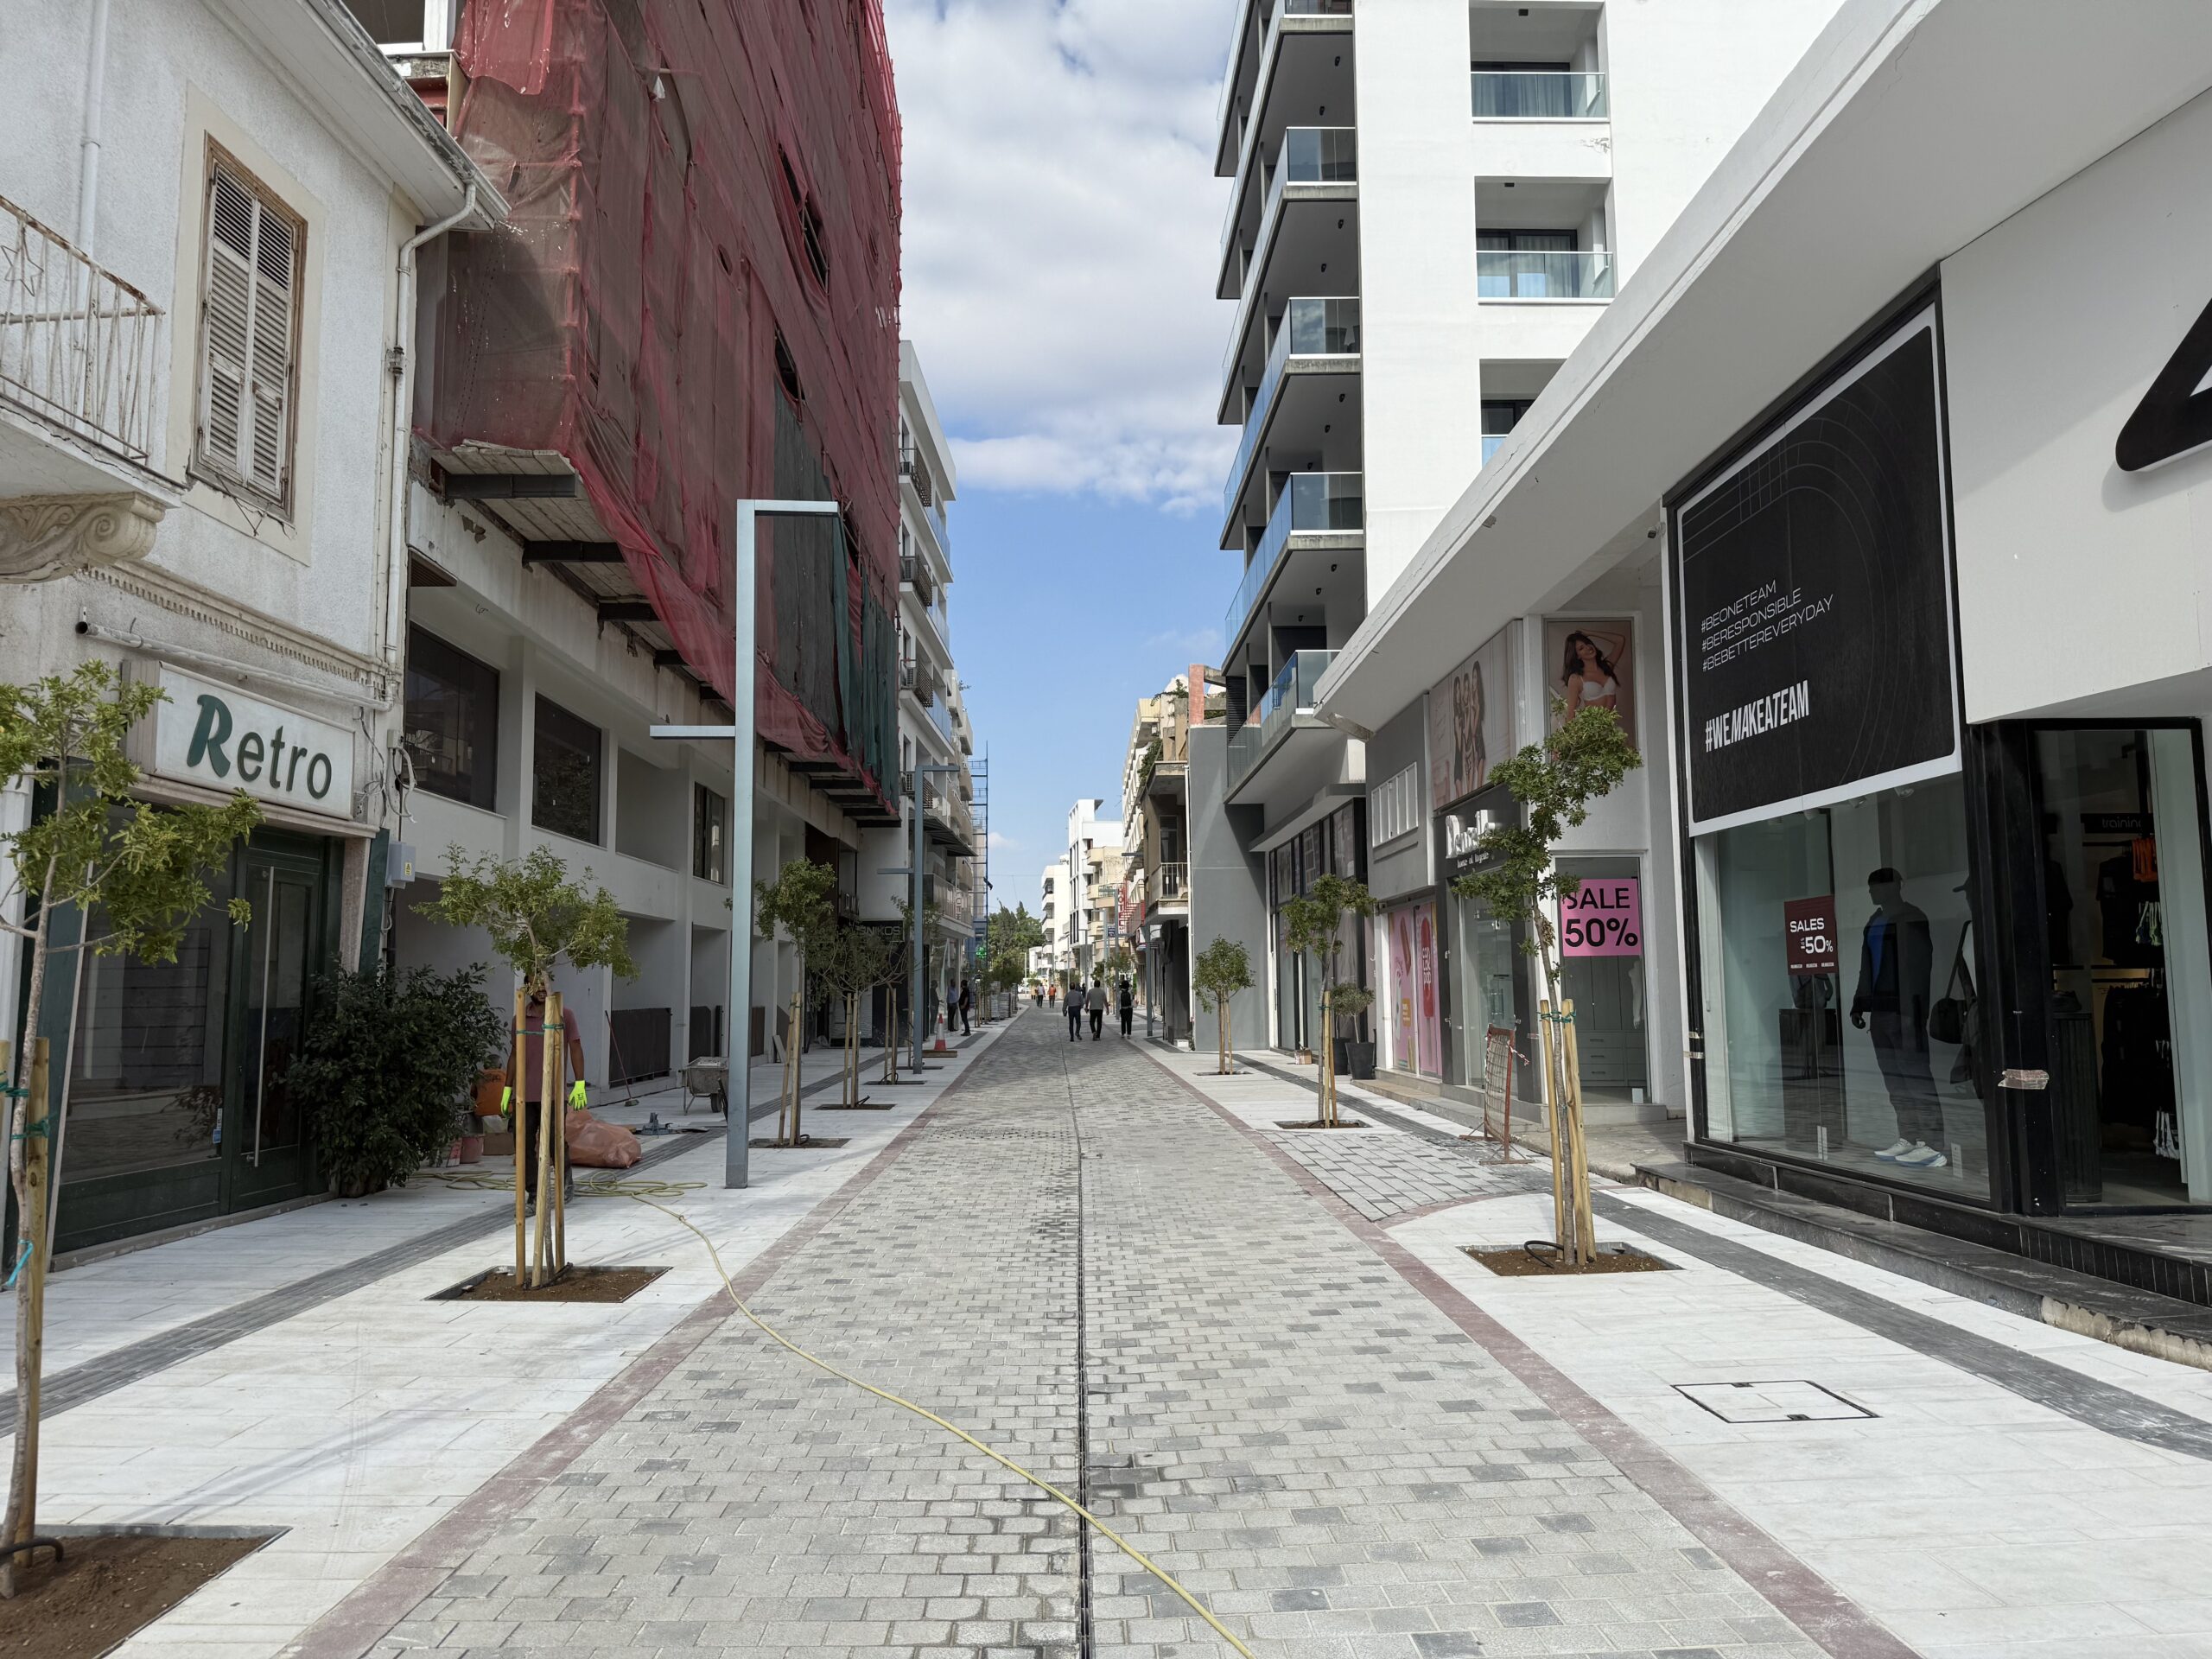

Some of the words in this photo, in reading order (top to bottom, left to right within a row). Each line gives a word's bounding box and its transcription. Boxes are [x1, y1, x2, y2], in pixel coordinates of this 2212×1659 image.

[1700, 580, 1777, 632] #BEONETEAM
[1701, 588, 1802, 652] #BERESPONSIBLE
[1702, 594, 1834, 672] #BEBETTEREVERYDAY
[187, 694, 332, 799] Retro
[1705, 679, 1809, 753] #WEMAKEATEAM
[1565, 918, 1638, 948] 50%
[1789, 917, 1825, 933] SALES
